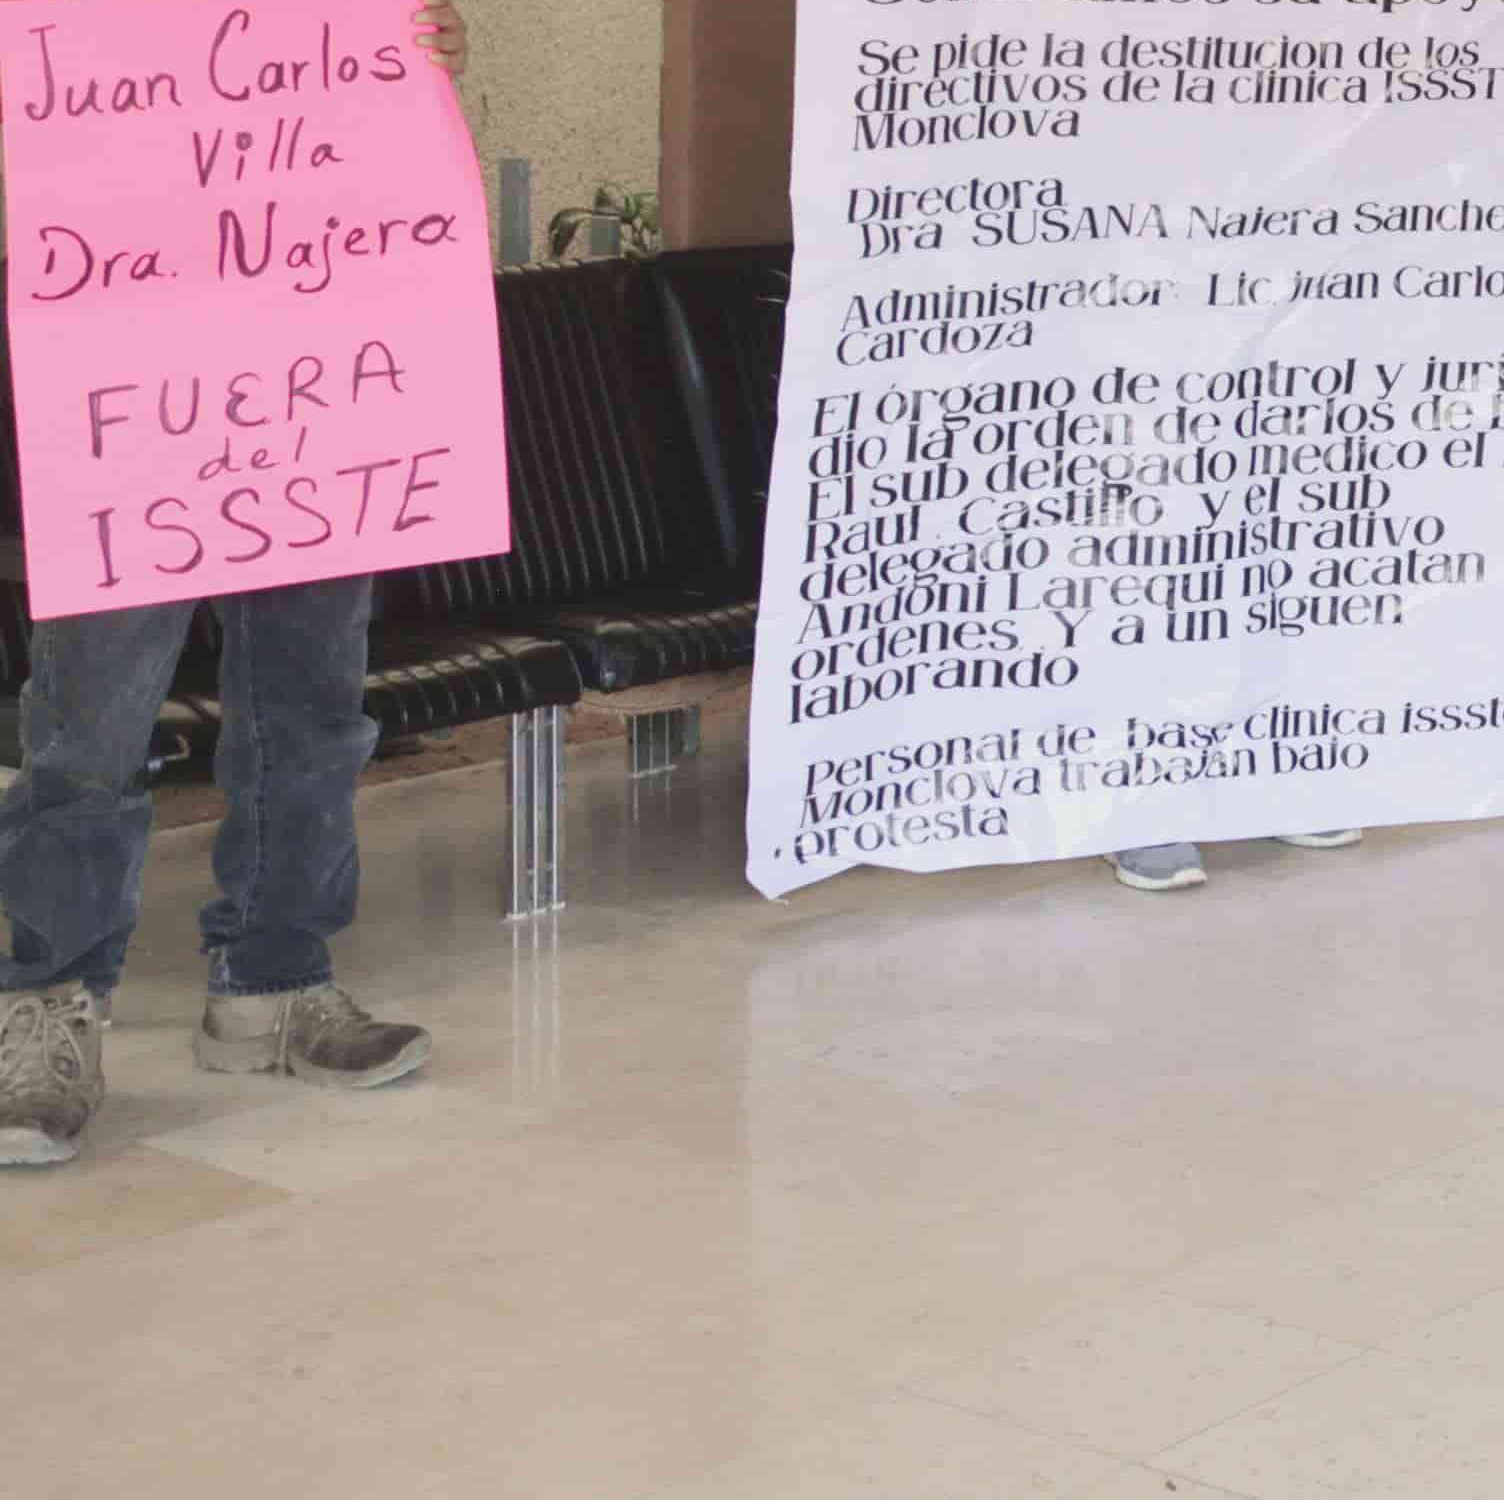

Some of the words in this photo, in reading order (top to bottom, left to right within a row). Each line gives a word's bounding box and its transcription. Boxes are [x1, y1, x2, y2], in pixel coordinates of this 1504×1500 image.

[25, 23, 182, 121] Juan
[209, 8, 407, 101] Carlos
[857, 39, 919, 77] Se
[933, 32, 1027, 78] pide
[1042, 33, 1084, 68] la
[1100, 33, 1344, 71] destitucion
[1358, 37, 1411, 69] de
[1425, 36, 1480, 70] los
[854, 69, 1088, 114] directivos
[1102, 70, 1160, 103] de
[1174, 70, 1215, 103] la
[1229, 69, 1368, 104] clinica
[192, 117, 344, 188] Villa
[853, 105, 1081, 151] Monclova
[847, 177, 1064, 224] Directora
[859, 219, 943, 259] Dra
[971, 203, 1169, 248] SUSANA
[1186, 204, 1339, 239] Najera
[218, 202, 457, 293] Najera
[836, 319, 1034, 366] Cardoza
[87, 340, 406, 459] FUERA
[811, 391, 862, 438] El
[1092, 366, 1160, 404] de
[1176, 358, 1356, 404] control
[907, 424, 954, 462] la
[973, 409, 1133, 454] orden
[1154, 406, 1221, 445] de
[1235, 396, 1395, 439] darlos
[198, 426, 306, 481] del
[807, 474, 854, 521] El
[869, 462, 968, 509] sub
[985, 446, 1238, 498] delegado
[1248, 437, 1427, 477] medico
[1442, 433, 1483, 468] el
[88, 447, 451, 588] ISSSTE
[1298, 474, 1391, 513] sub
[799, 534, 1049, 603] delegado
[1067, 511, 1445, 567] administrativo
[797, 575, 988, 644] Andoni
[1007, 566, 1225, 612] Larequi
[1242, 558, 1293, 597] no
[1309, 549, 1484, 588] acatan
[1052, 610, 1094, 648] Y
[1166, 607, 1231, 643] un
[789, 654, 1079, 724] laborando
[799, 764, 1041, 828] Monclova
[1272, 738, 1369, 774] bajo
[806, 729, 1019, 796] Personal
[1037, 724, 1096, 757] de
[1243, 703, 1386, 741] clinica
[794, 804, 1009, 864] protesta
